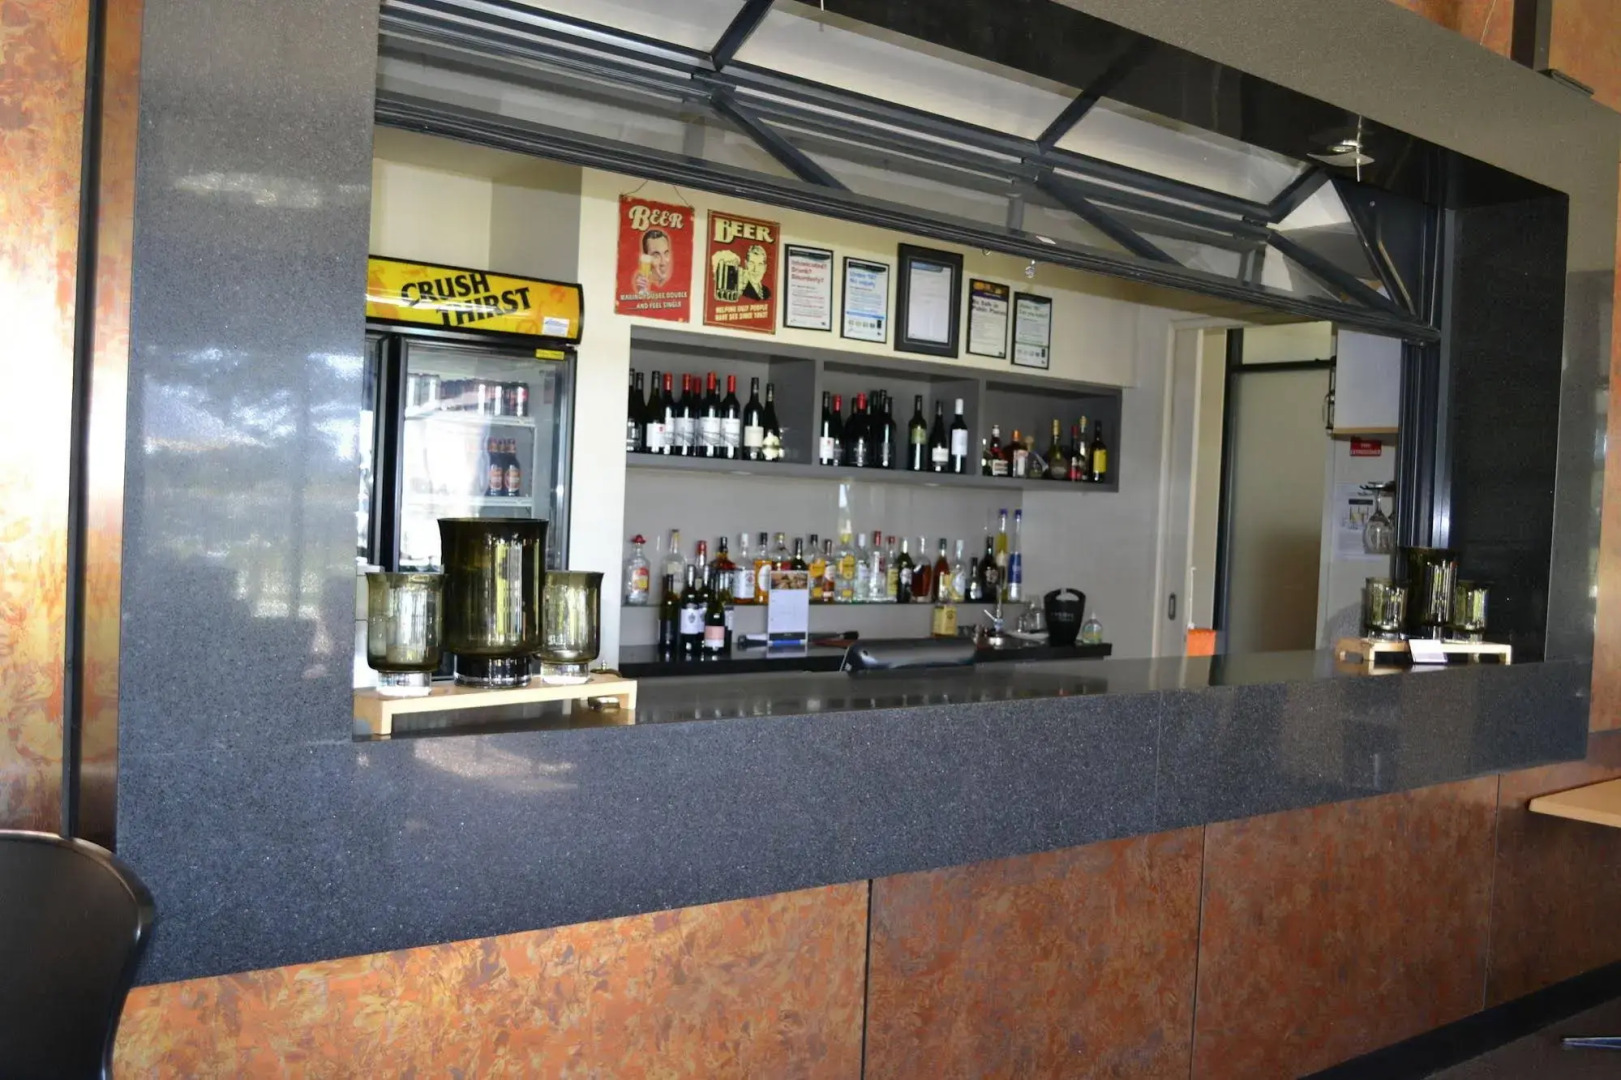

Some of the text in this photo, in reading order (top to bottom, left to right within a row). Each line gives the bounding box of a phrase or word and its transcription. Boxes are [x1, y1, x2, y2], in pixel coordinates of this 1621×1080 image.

[628, 205, 684, 231] BEER
[714, 217, 774, 243] BEER
[401, 271, 490, 306] CRUSH
[436, 287, 532, 326] THIRST
